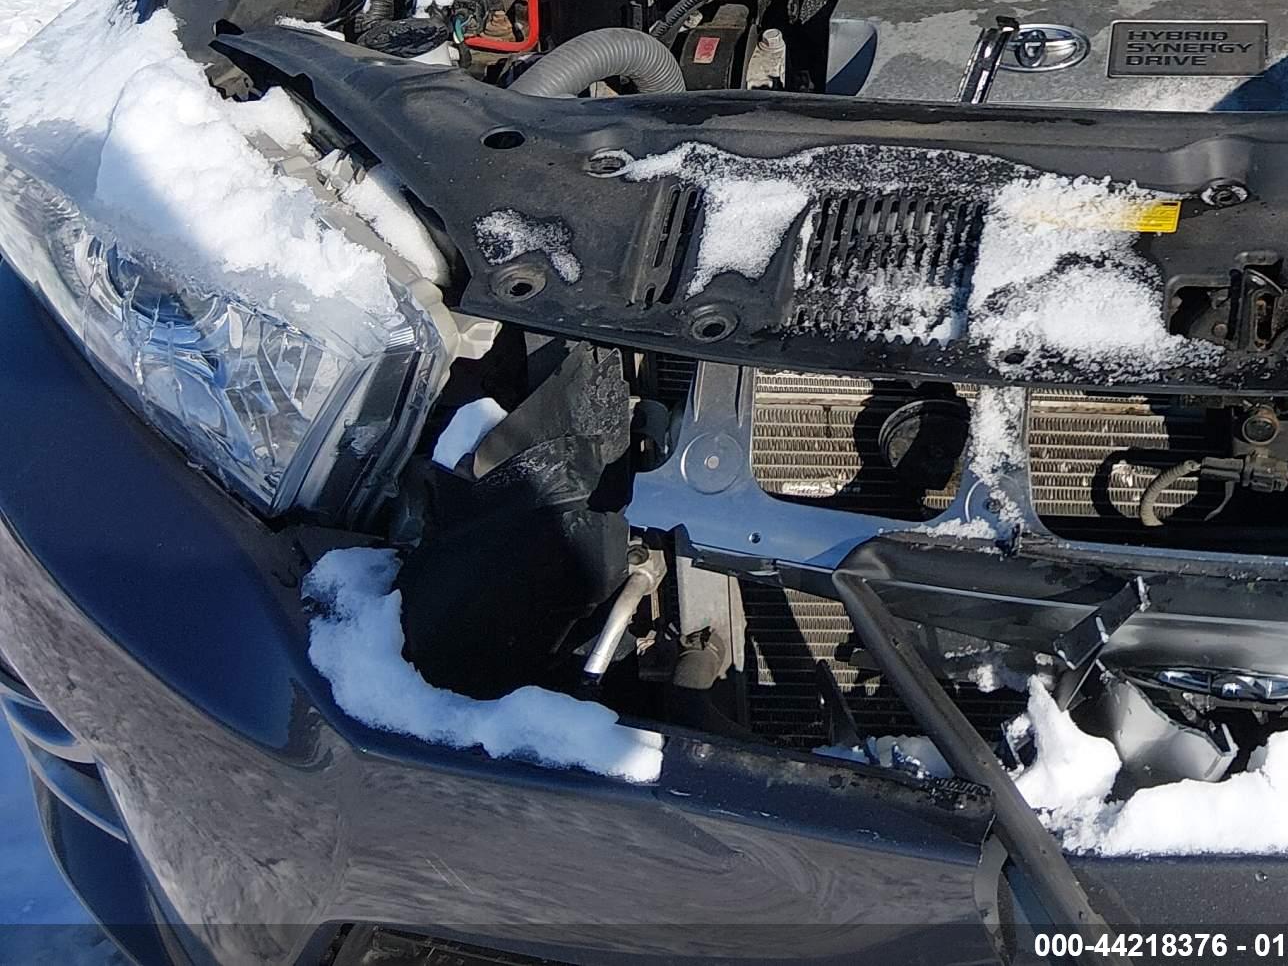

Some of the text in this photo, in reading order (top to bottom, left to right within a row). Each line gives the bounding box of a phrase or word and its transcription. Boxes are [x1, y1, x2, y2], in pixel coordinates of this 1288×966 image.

[1127, 30, 1229, 41] HYBRID
[1126, 42, 1253, 54] SYNERGY
[1125, 54, 1208, 66] DRIVE
